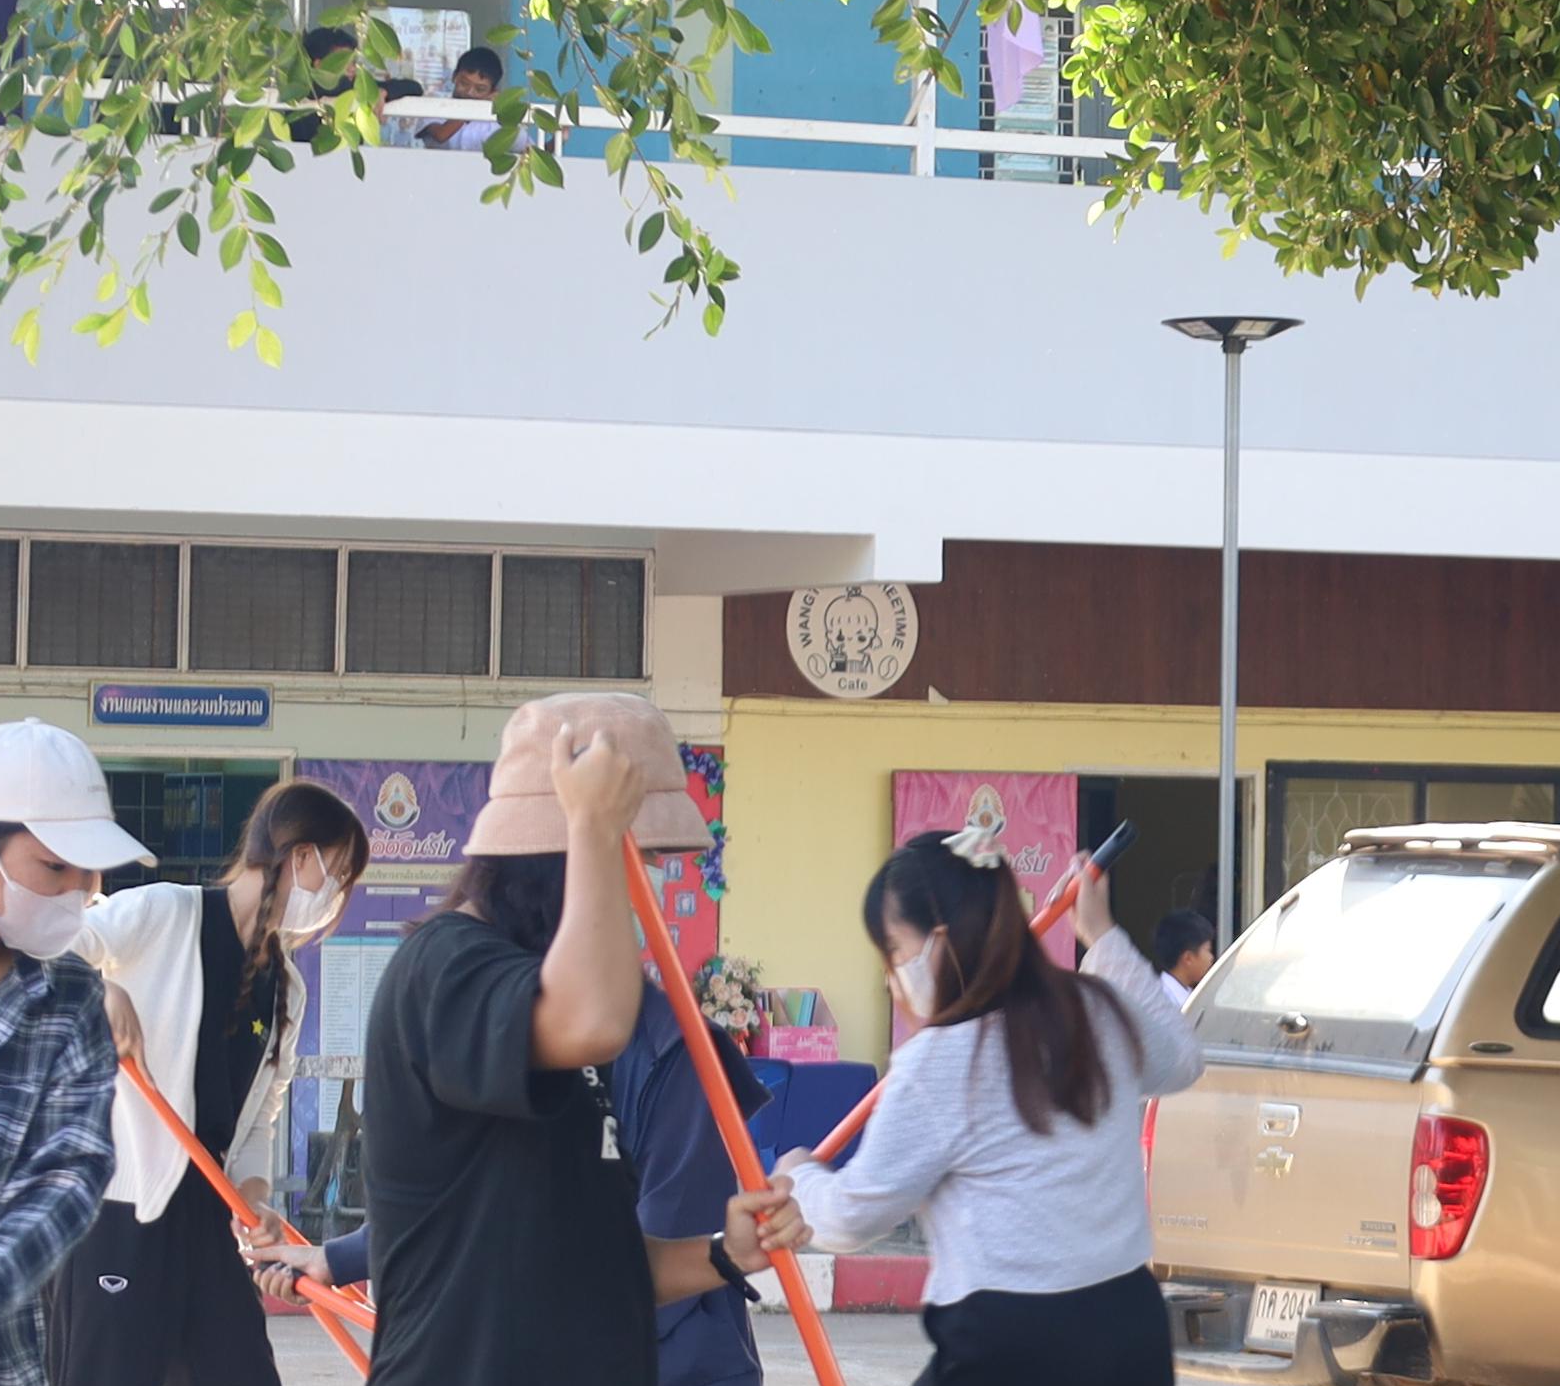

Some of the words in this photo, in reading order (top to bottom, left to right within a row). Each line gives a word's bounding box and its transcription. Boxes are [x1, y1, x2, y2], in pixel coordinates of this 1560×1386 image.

[799, 587, 821, 649] WANG
[882, 583, 908, 650] EETIME
[837, 676, 869, 691] Cafe
[100, 694, 264, 717] งานแผนงานและงบประมาณ
